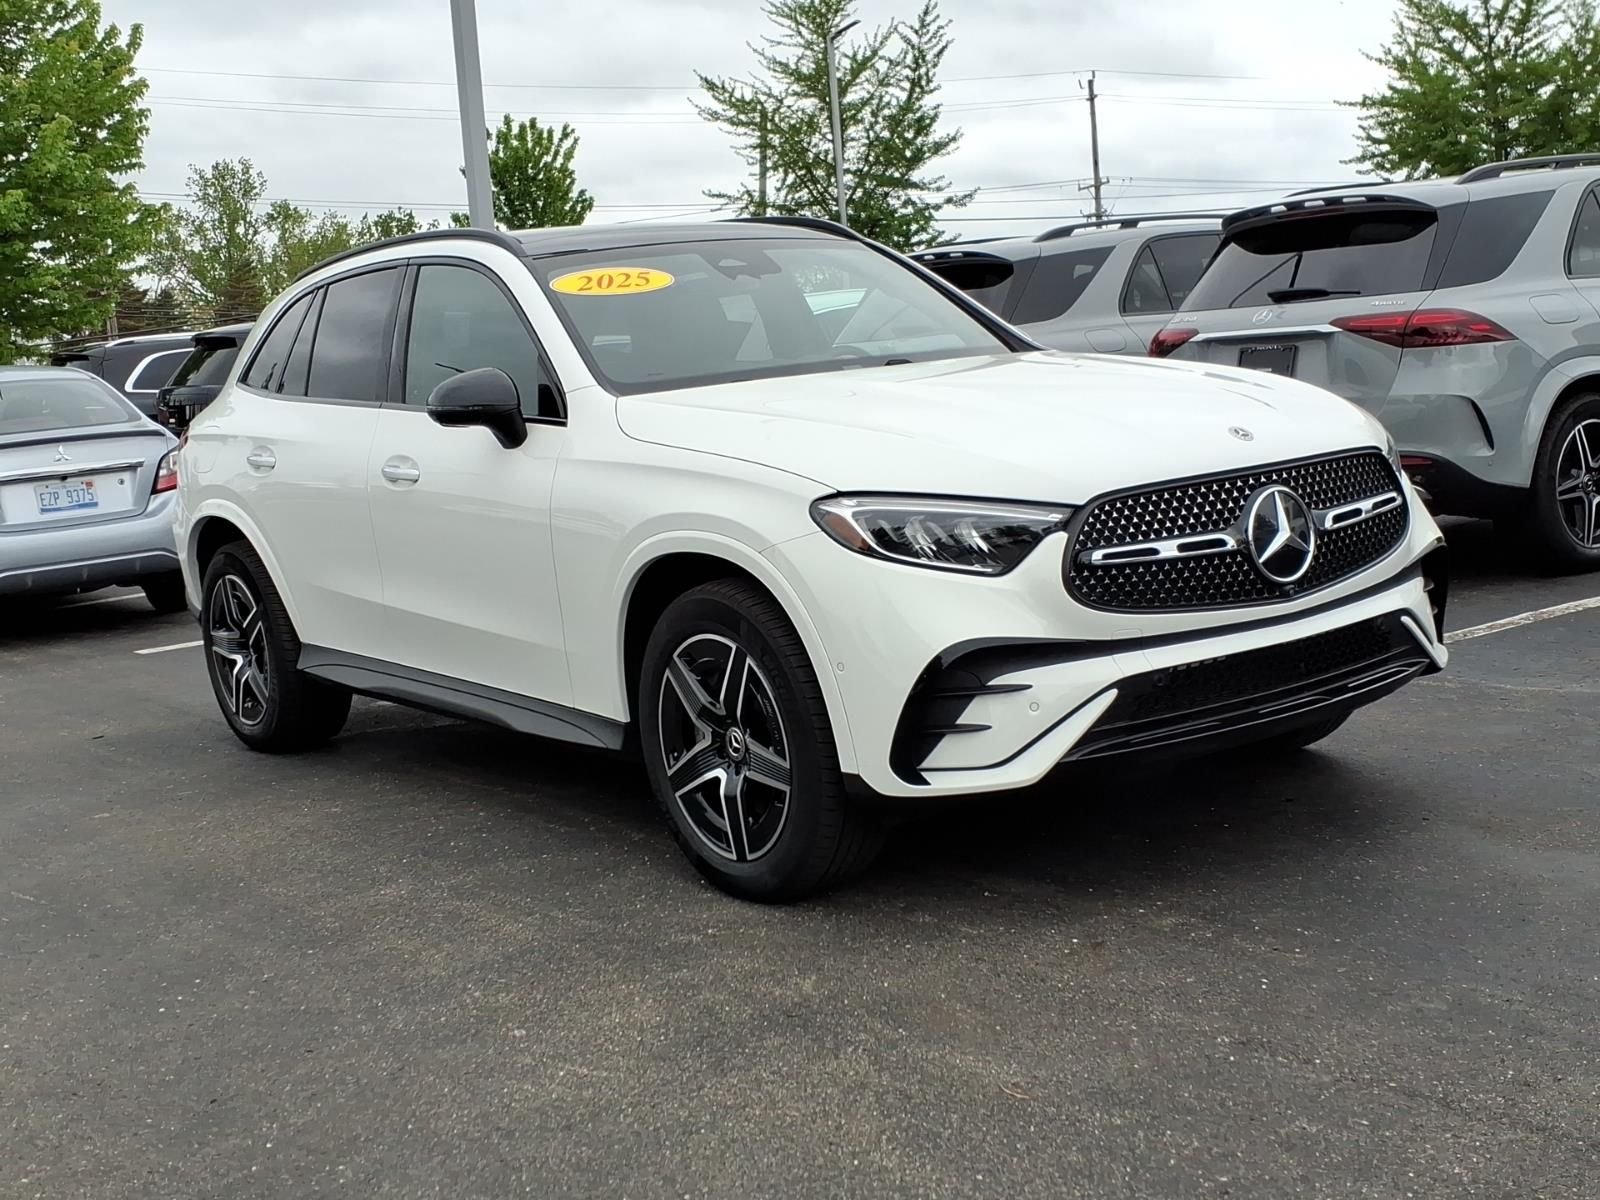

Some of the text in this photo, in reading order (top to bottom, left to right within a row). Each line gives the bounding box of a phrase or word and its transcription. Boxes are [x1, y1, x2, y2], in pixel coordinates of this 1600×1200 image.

[577, 271, 650, 292] 2025
[40, 488, 95, 507] EZP 9375
